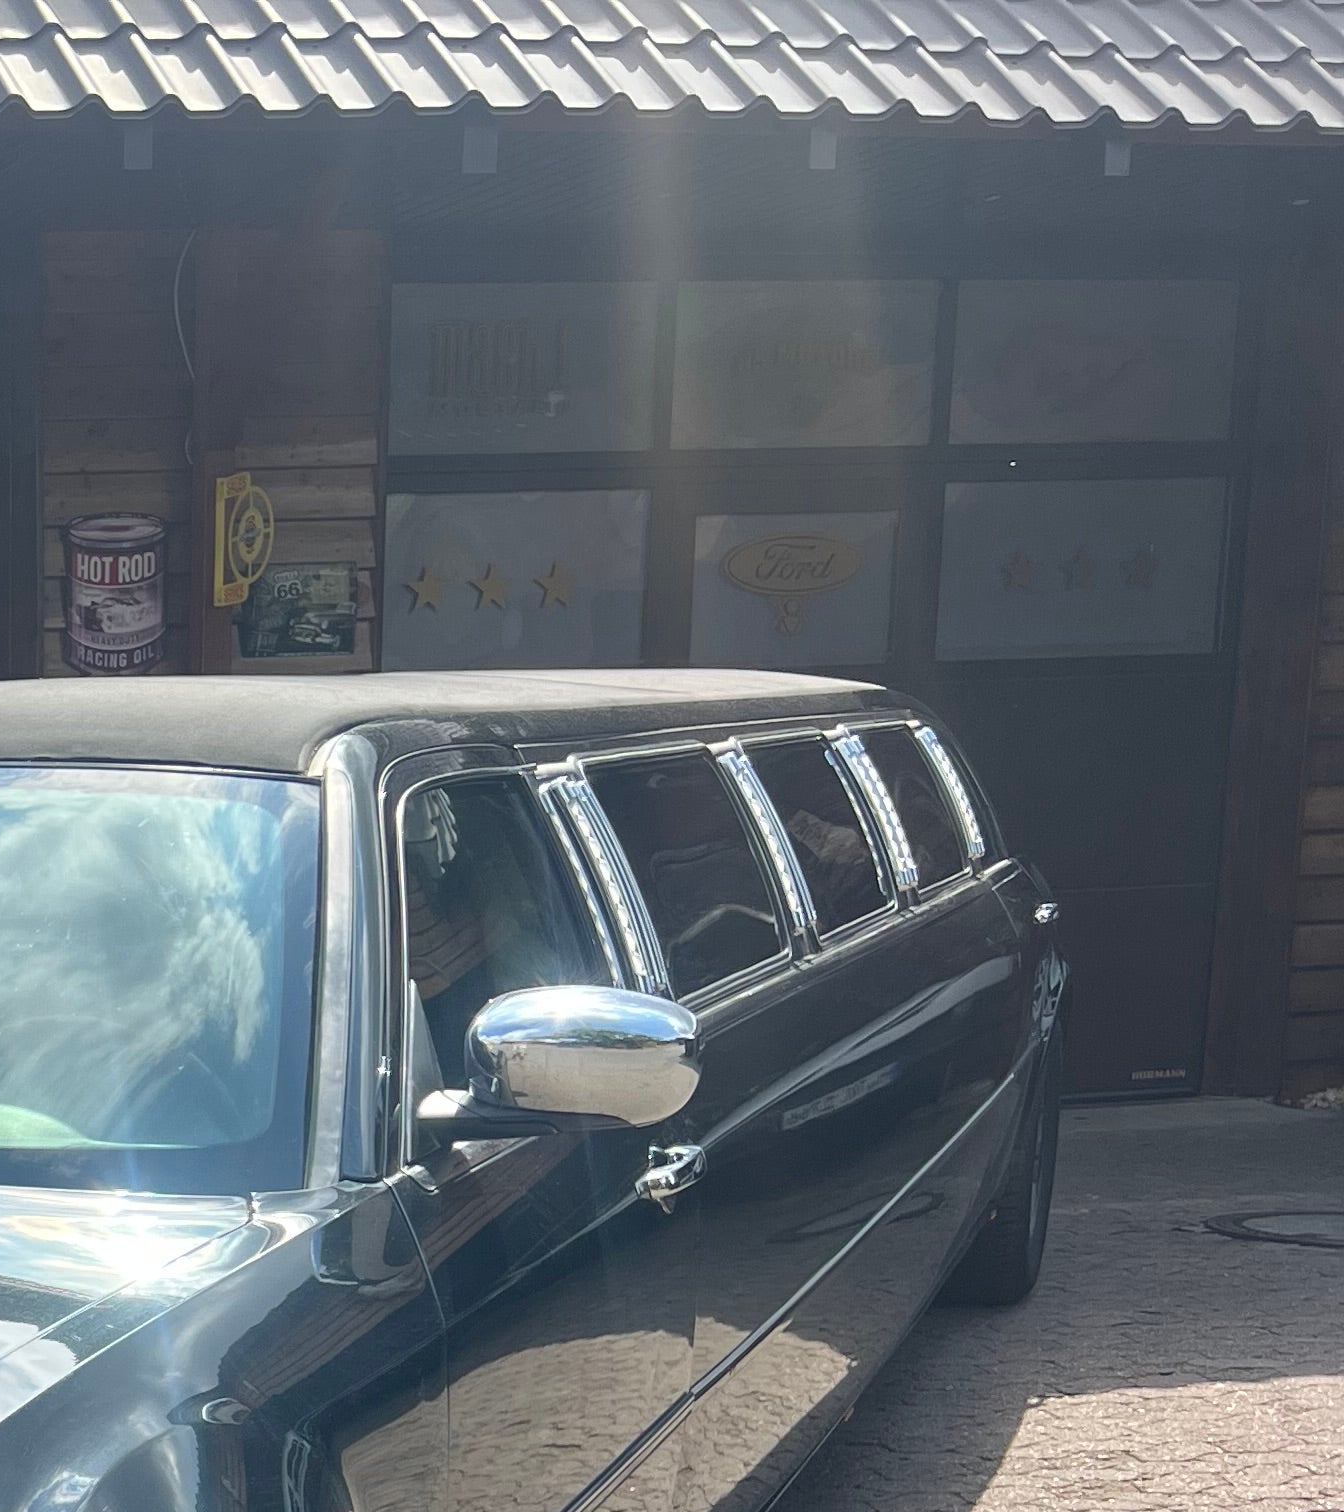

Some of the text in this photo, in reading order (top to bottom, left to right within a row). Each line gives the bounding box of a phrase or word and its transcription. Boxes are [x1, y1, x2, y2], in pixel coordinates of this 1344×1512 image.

[76, 551, 156, 584] HOT ROD
[755, 543, 836, 581] Ford
[277, 582, 300, 599] 66
[76, 645, 155, 669] RACING OIL
